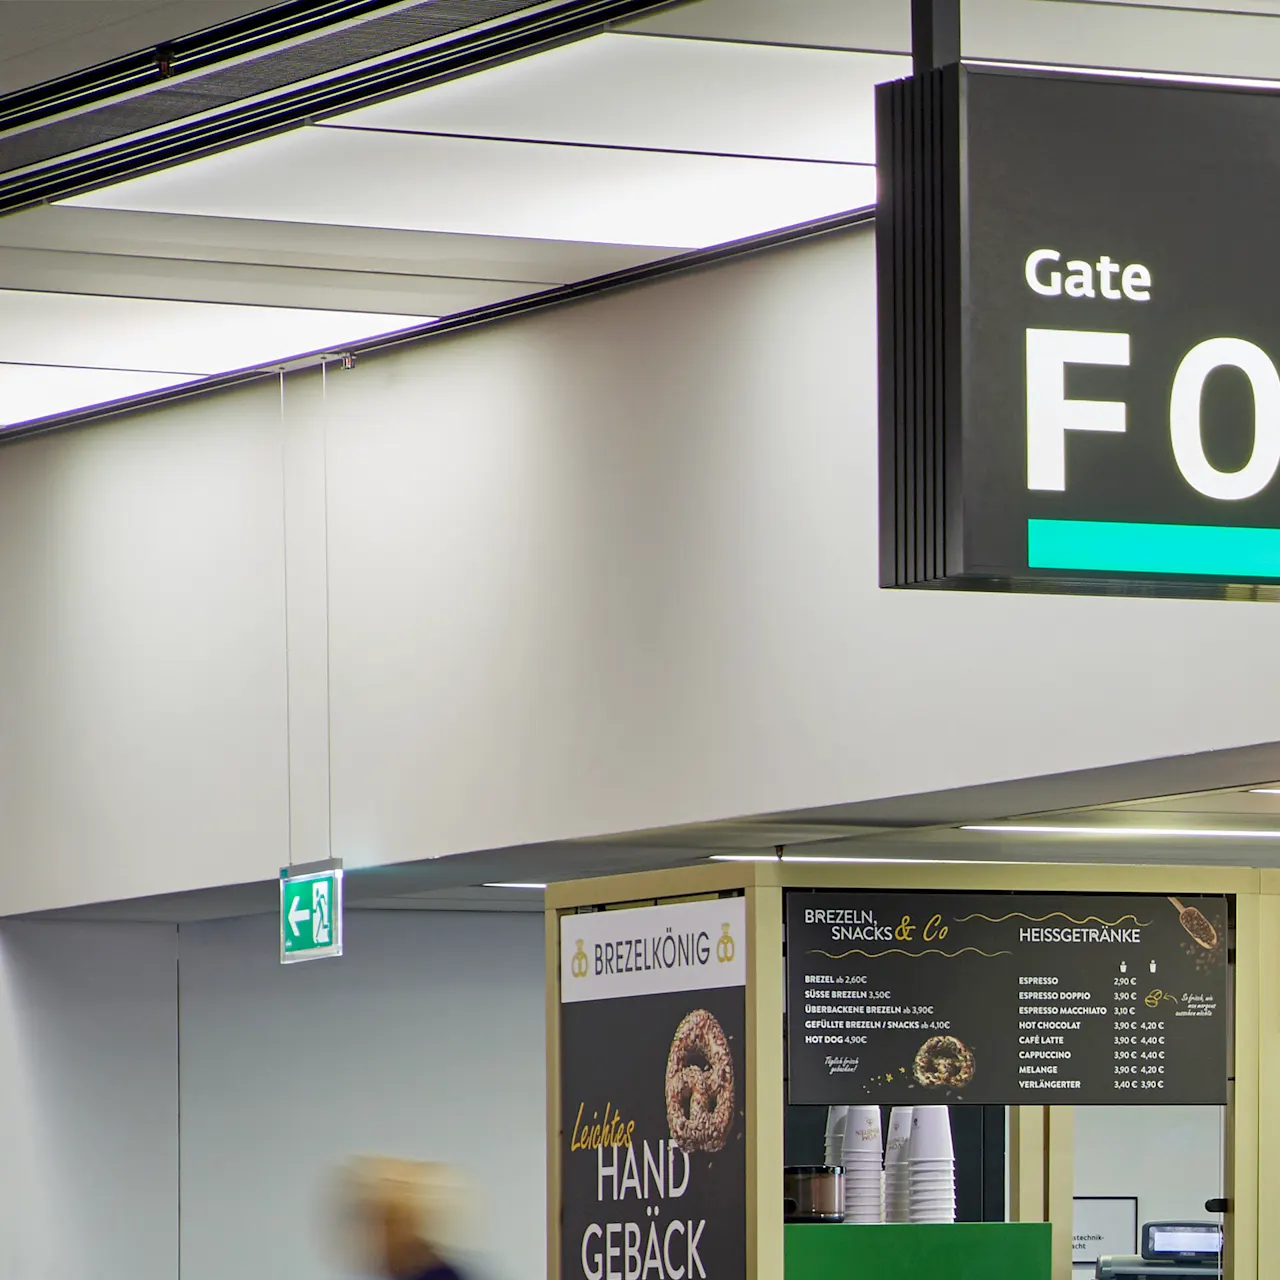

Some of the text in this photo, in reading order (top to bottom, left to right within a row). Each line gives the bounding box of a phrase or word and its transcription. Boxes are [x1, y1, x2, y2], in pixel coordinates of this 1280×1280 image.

[1025, 249, 1151, 301] Gate
[1026, 328, 1130, 491] F
[805, 909, 877, 925] BREZELN,
[832, 914, 949, 941] SNACKS & Co
[1019, 926, 1141, 943] HEISSGETRÄNKE
[594, 927, 711, 976] BREZELKÖNIG
[805, 975, 834, 984] BREZEL
[1019, 977, 1059, 985] ESPRESSO
[1114, 978, 1129, 986] 2,90
[805, 989, 830, 998] SÜSSE
[831, 990, 867, 998] BREZELN
[1019, 992, 1059, 1000] ESPRESSO
[1060, 992, 1091, 1000] DOPPIO
[1114, 993, 1129, 1001] 3,90
[805, 1004, 865, 1013] ÜBERBACKENE
[866, 1005, 902, 1013] BREZELN
[1019, 1007, 1059, 1015] ESPRESSO
[1060, 1007, 1107, 1015] MACCHIATO
[1114, 1008, 1128, 1016] 3,10
[805, 1019, 844, 1029] GEFÜLLTE
[846, 1021, 881, 1029] BREZELN
[887, 1021, 920, 1029] SNACKS
[1019, 1022, 1036, 1030] HOT
[1037, 1022, 1081, 1030] CHOCOLAT
[1114, 1022, 1129, 1031] 3,90
[1141, 1022, 1157, 1031] 4,20
[805, 1036, 823, 1044] HOT
[824, 1036, 843, 1044] DOG
[1019, 1035, 1040, 1044] CAFÉ
[1041, 1036, 1064, 1044] LATTE
[1114, 1037, 1129, 1045] 3,90
[1141, 1037, 1157, 1045] 4,40
[1019, 1051, 1072, 1059] CAPPUCCINO
[1114, 1052, 1129, 1060] 3,90
[1141, 1052, 1157, 1060] 4,40
[1019, 1066, 1058, 1074] MELANGE
[1114, 1066, 1129, 1075] 3,90
[1141, 1066, 1157, 1075] 4,20
[1019, 1079, 1081, 1089] VERLÄNGERTER
[1114, 1081, 1130, 1090] 3,40
[1141, 1081, 1157, 1090] 3,90
[571, 1102, 635, 1152] Leichtes
[597, 1138, 690, 1202] HAND
